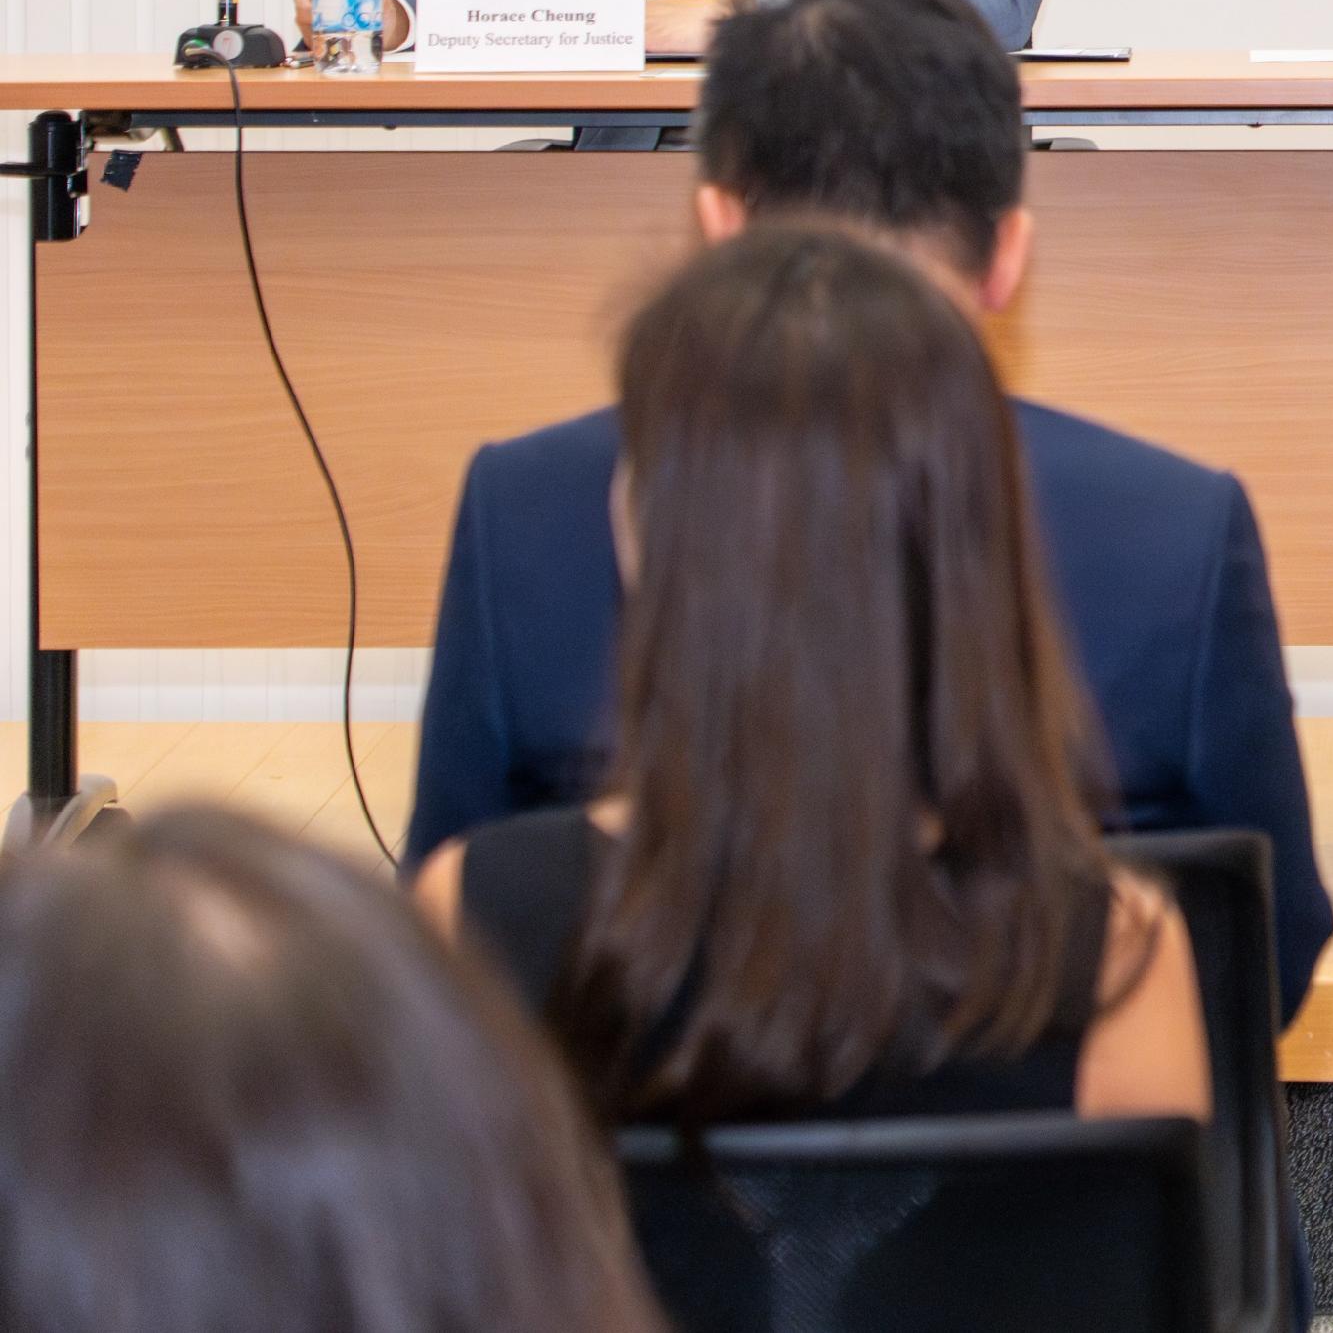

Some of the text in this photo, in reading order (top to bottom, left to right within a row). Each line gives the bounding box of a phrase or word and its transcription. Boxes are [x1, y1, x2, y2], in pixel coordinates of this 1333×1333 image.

[467, 9, 596, 25] Horace Cheung
[427, 32, 633, 49] Deputy Secretary for Justice
